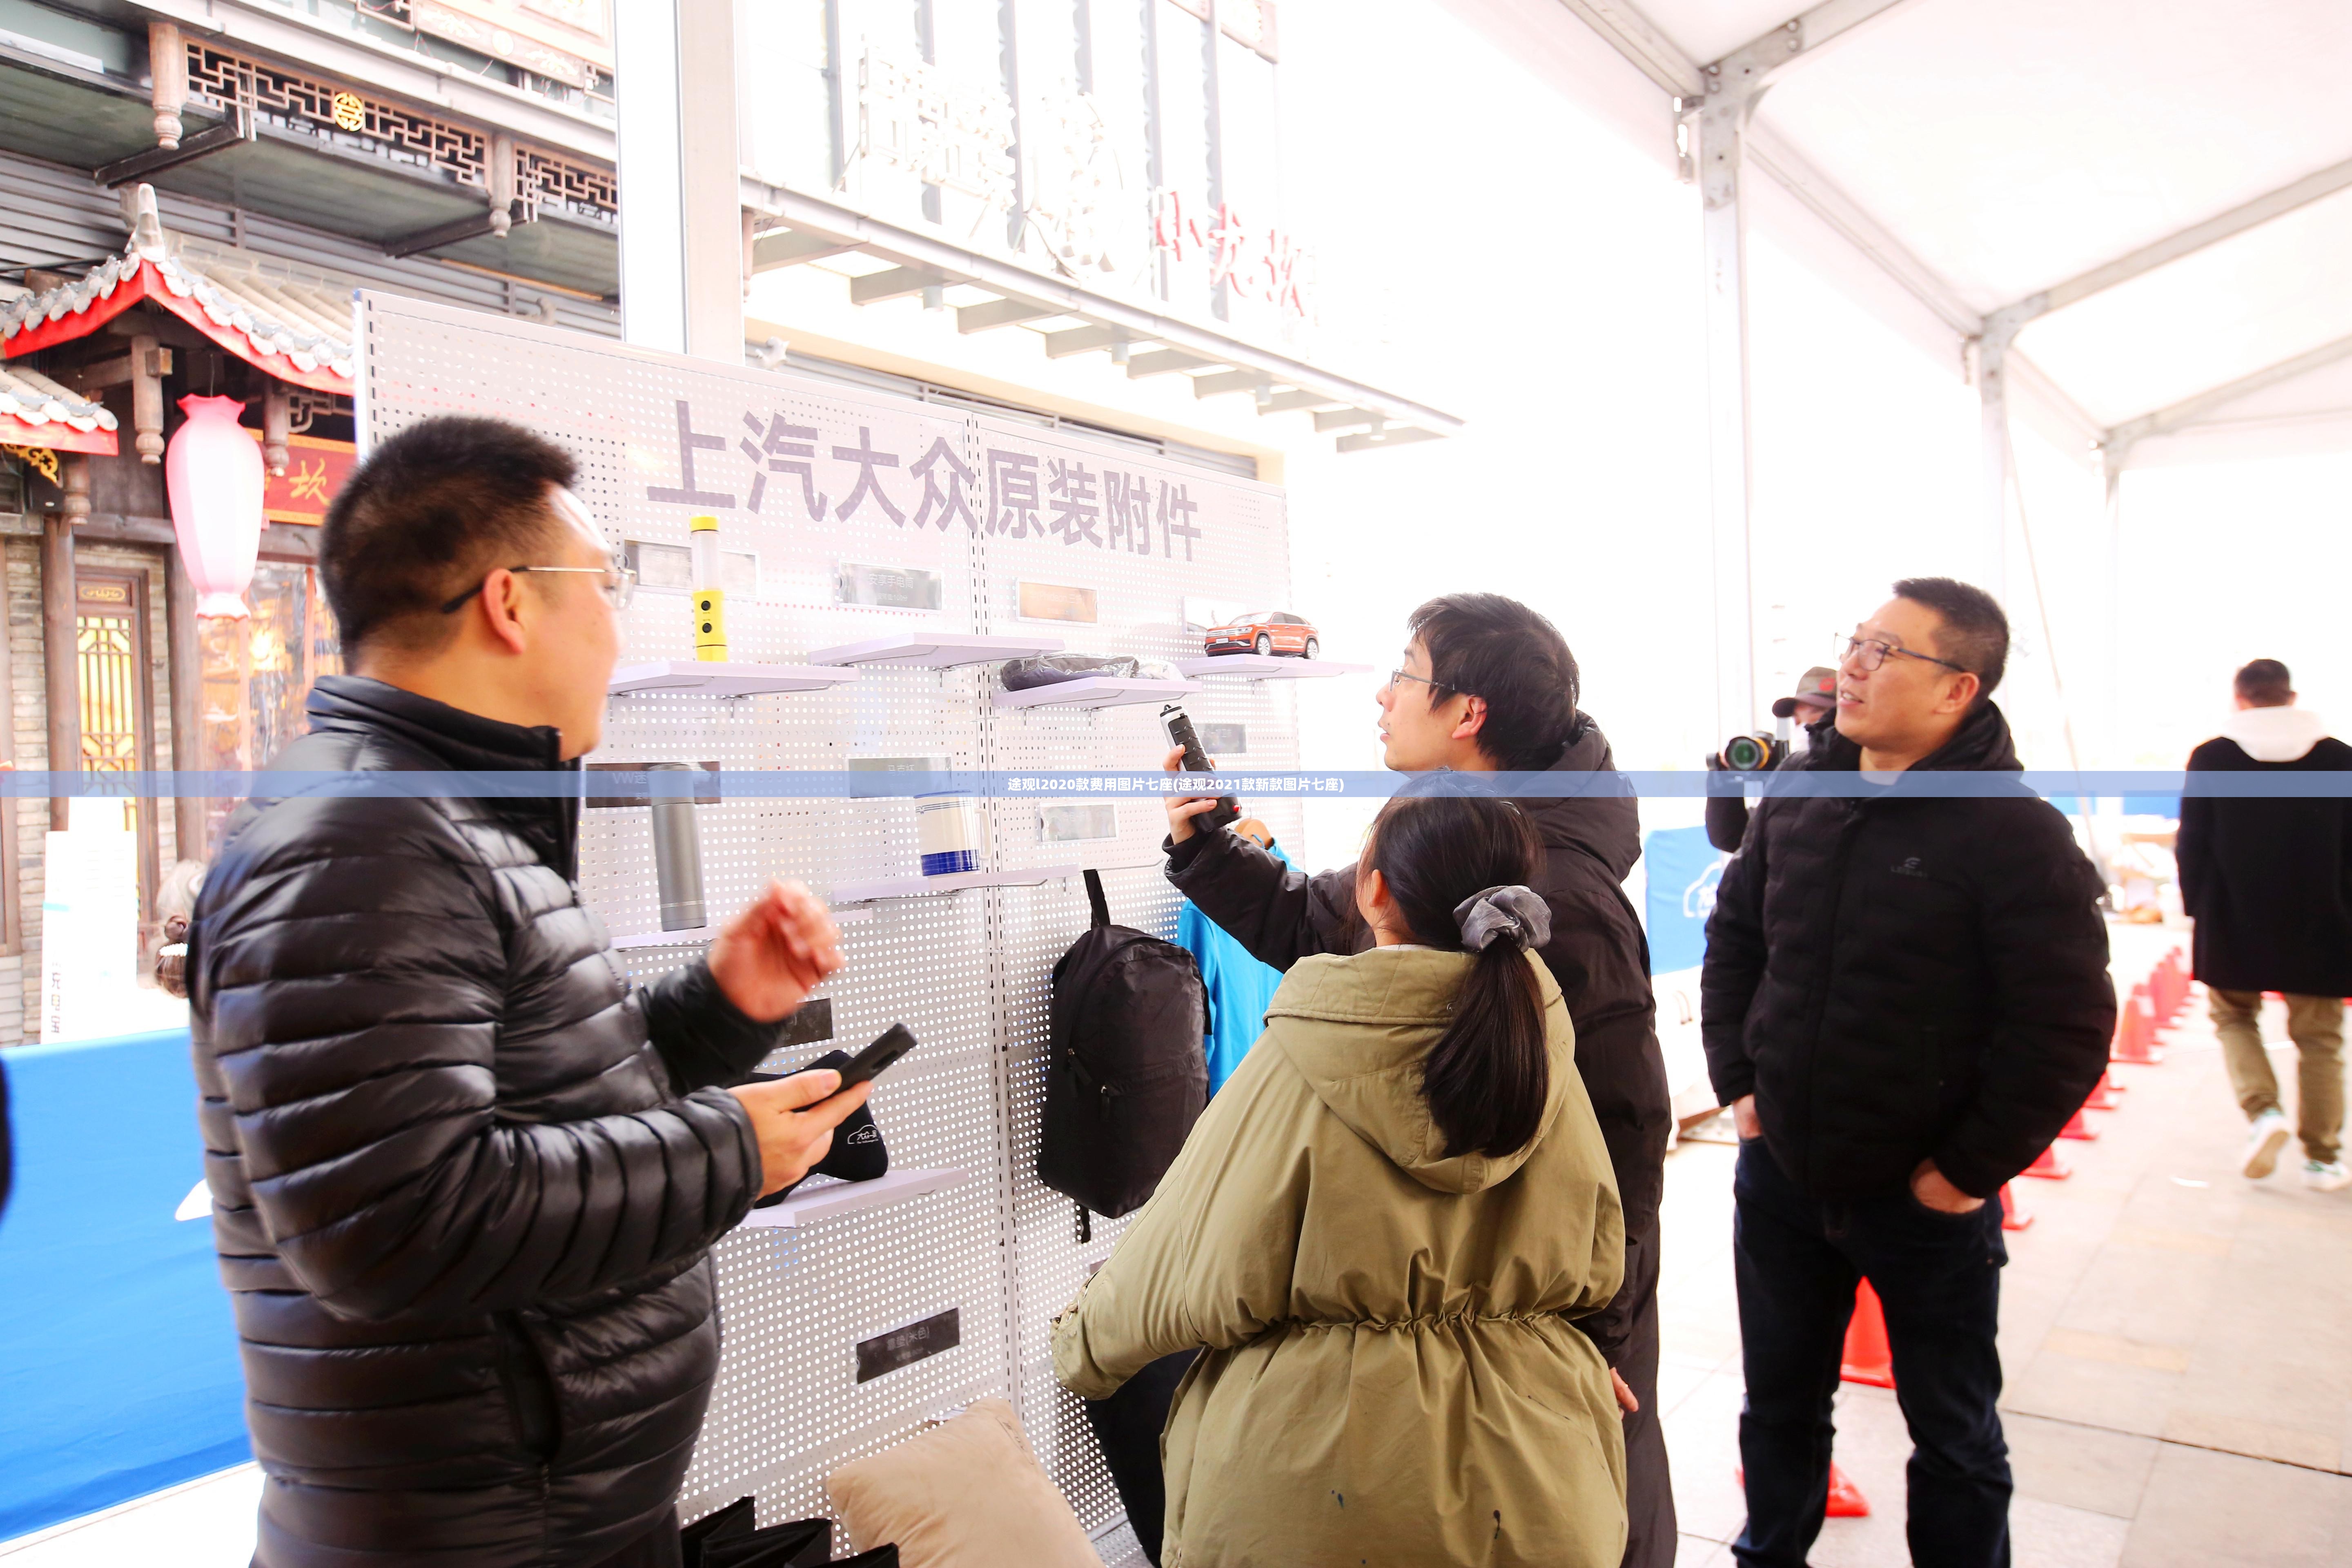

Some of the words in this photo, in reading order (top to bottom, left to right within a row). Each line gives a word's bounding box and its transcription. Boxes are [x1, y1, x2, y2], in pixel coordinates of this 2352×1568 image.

[647, 400, 1202, 562] 上汽大众原装附件
[869, 573, 914, 588] 安享手电筒
[888, 764, 915, 776] 马克杯
